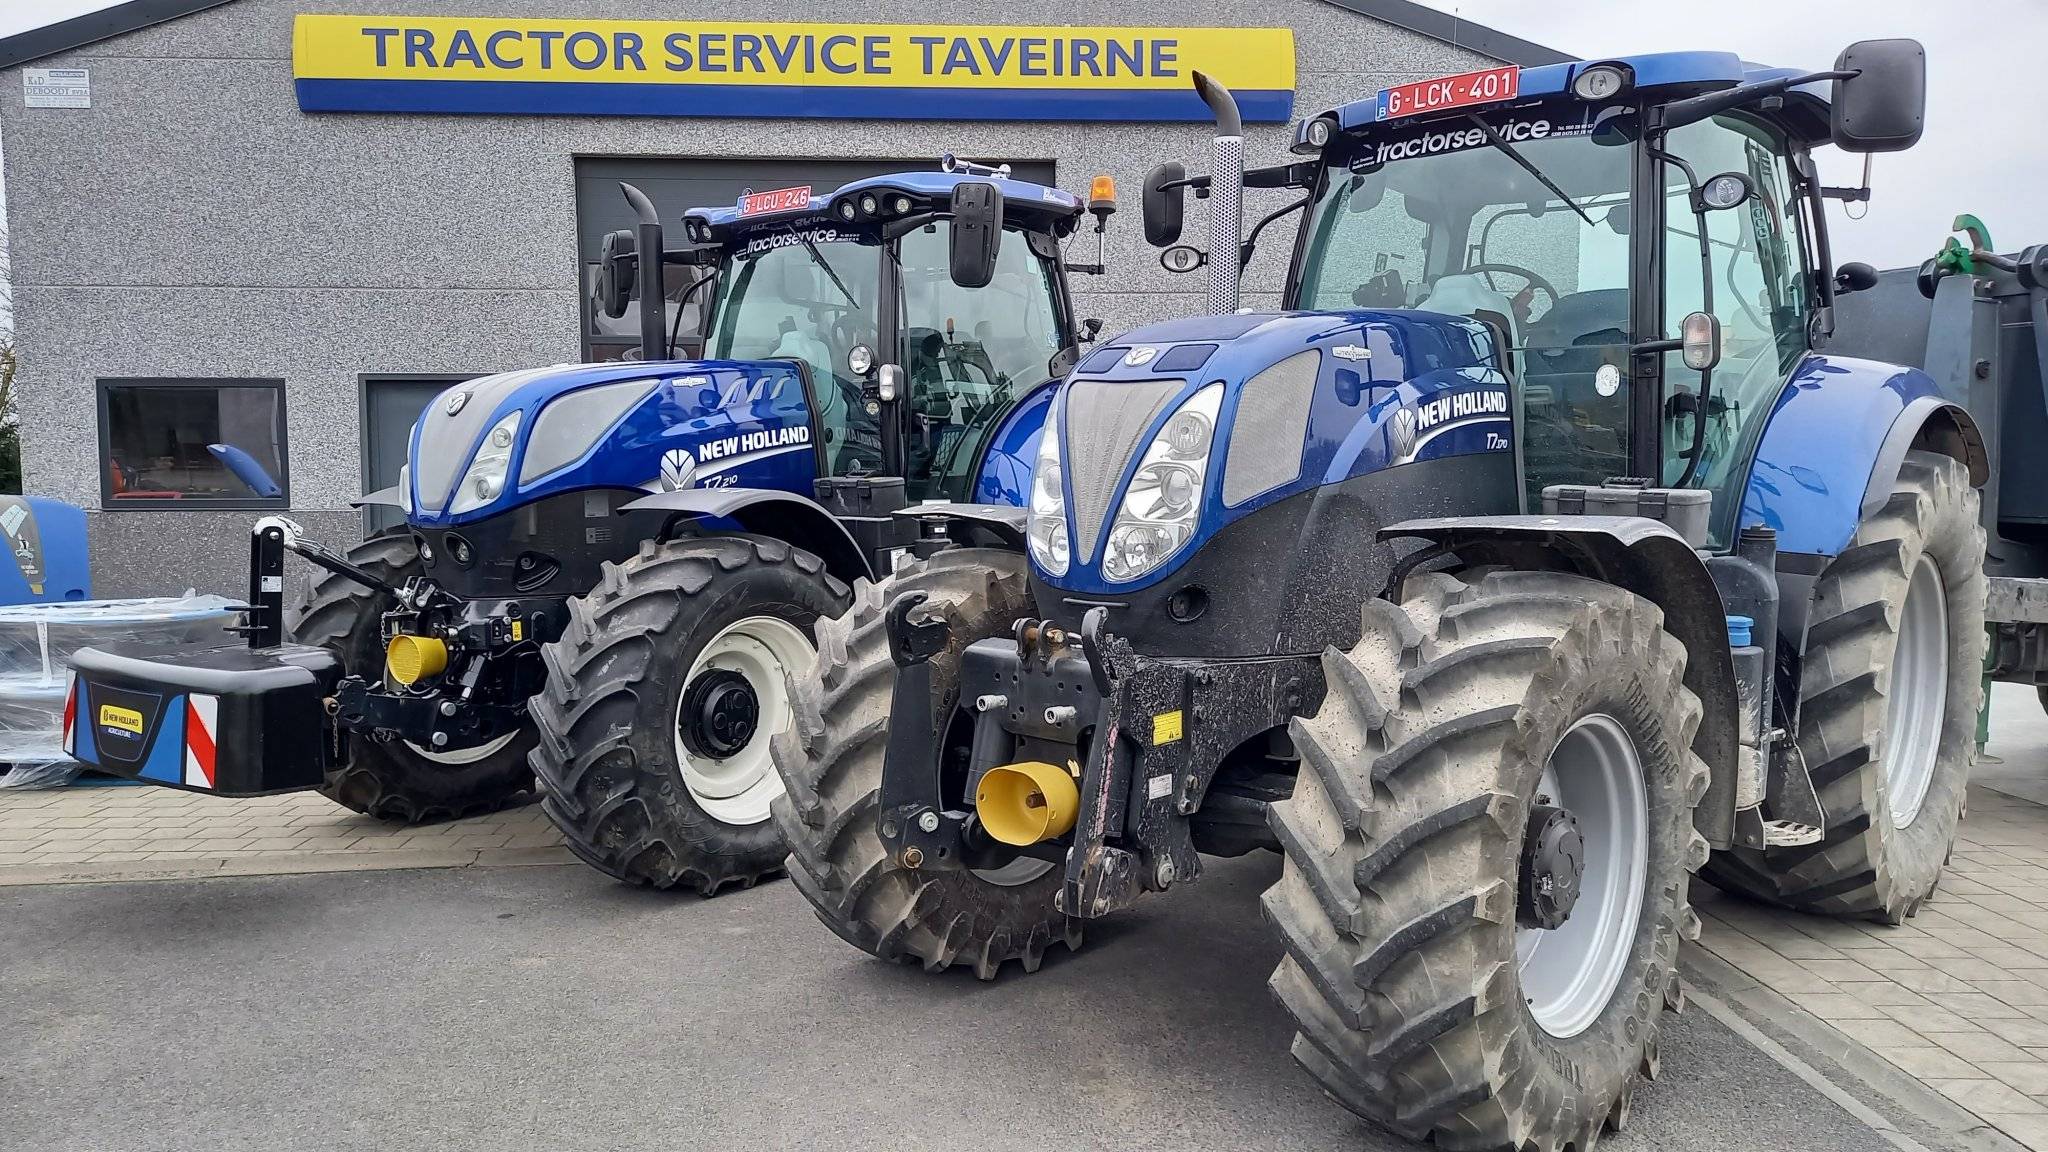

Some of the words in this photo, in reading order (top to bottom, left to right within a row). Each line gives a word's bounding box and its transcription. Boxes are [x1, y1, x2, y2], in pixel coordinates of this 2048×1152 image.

[362, 28, 647, 71] TRACTOR
[664, 33, 891, 75] SERVICE
[910, 37, 1178, 77] TAVEIRNE
[1379, 106, 1386, 117] B
[1389, 71, 1511, 114] G-LCK-401
[1376, 119, 1550, 163] tractorservice
[743, 189, 808, 213] G-LCU-246
[746, 227, 837, 254] tractorservice
[1418, 396, 1451, 431] NEW
[1452, 391, 1507, 418] HOLLAND
[699, 436, 739, 462] NEW
[741, 426, 809, 452] HOLLAND
[109, 713, 118, 722] NEW
[118, 716, 139, 727] HOLLAND
